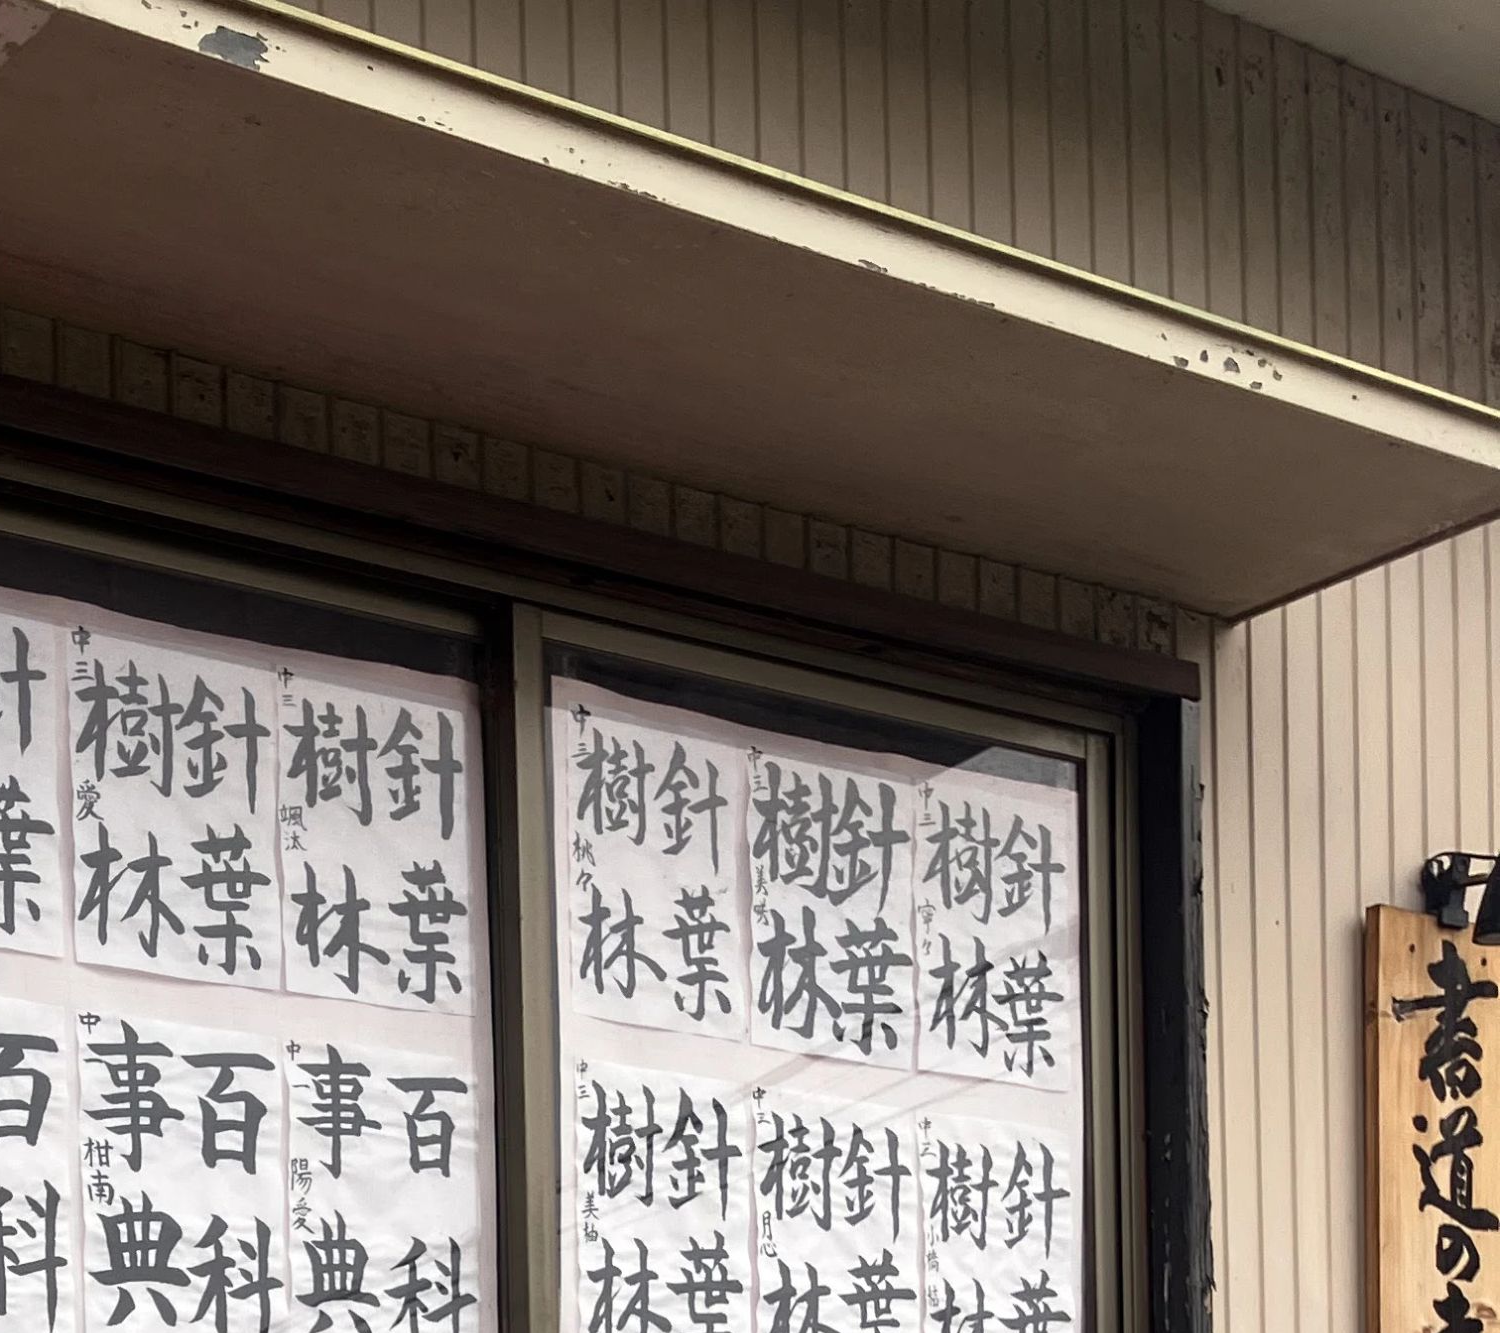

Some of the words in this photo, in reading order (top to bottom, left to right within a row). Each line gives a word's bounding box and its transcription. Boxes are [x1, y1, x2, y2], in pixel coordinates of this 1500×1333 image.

[71, 625, 94, 683] 中三
[277, 666, 297, 708] 中三
[75, 658, 185, 958] 樹林
[175, 674, 271, 975] 針葉
[283, 698, 391, 994] 樹林
[376, 706, 468, 1003] 針葉
[576, 727, 667, 999] 樹林
[654, 740, 732, 1021] 針葉
[751, 761, 841, 1039] 樹林
[828, 777, 912, 1055] 針葉
[922, 801, 1003, 1058] 樹林
[991, 814, 1065, 1078] 針葉
[83, 1019, 192, 1327] 事典
